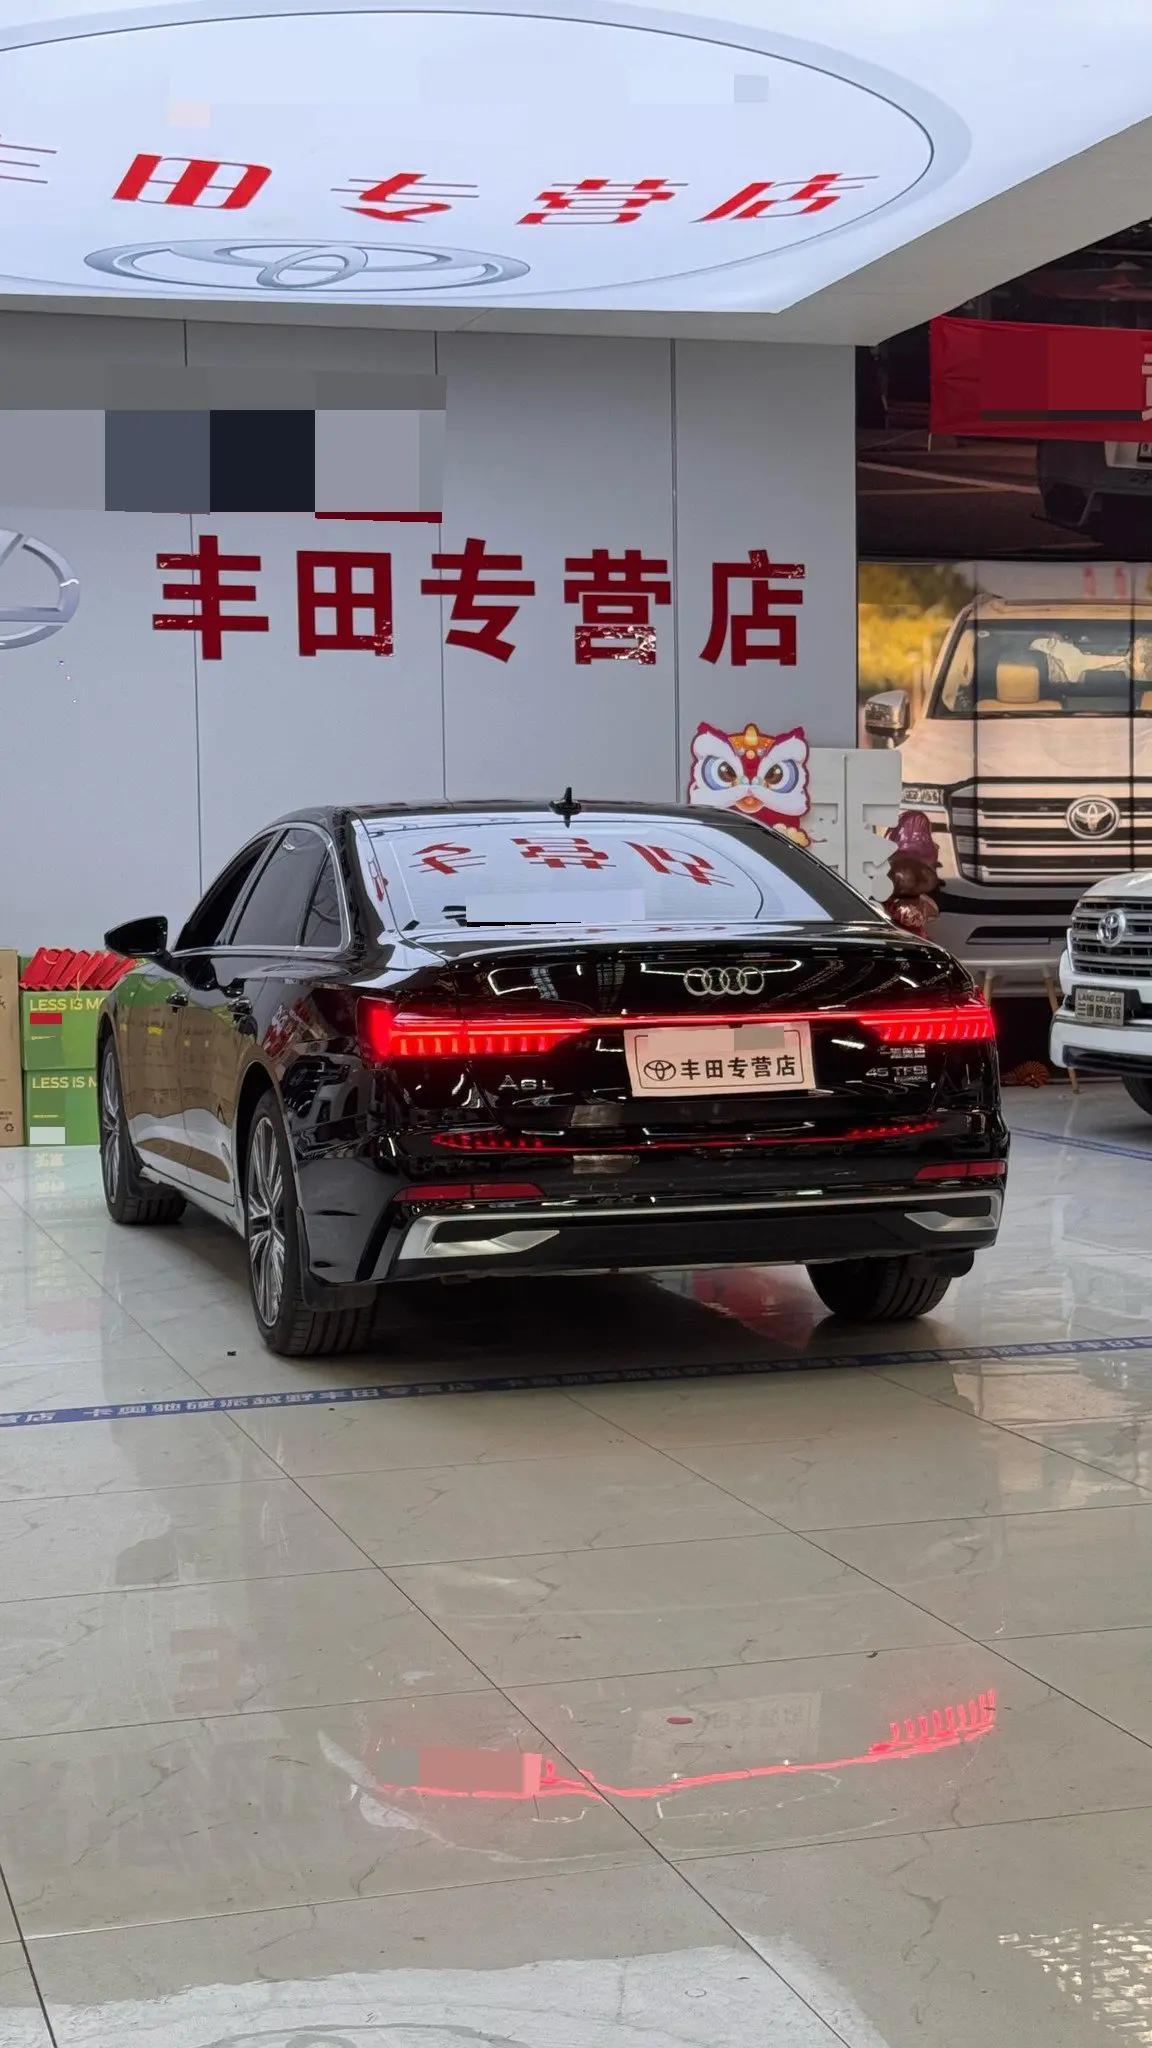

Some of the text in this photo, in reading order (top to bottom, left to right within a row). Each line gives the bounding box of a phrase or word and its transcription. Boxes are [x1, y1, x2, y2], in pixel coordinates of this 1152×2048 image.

[152, 535, 806, 667] 丰田专营店
[30, 999, 66, 1011] LESS
[70, 998, 83, 1010] IS
[681, 1054, 796, 1081] 丰田专营店
[865, 1067, 889, 1078] 45
[32, 1076, 69, 1089] LESS
[72, 1076, 85, 1089] IS
[498, 1074, 554, 1091] A6L
